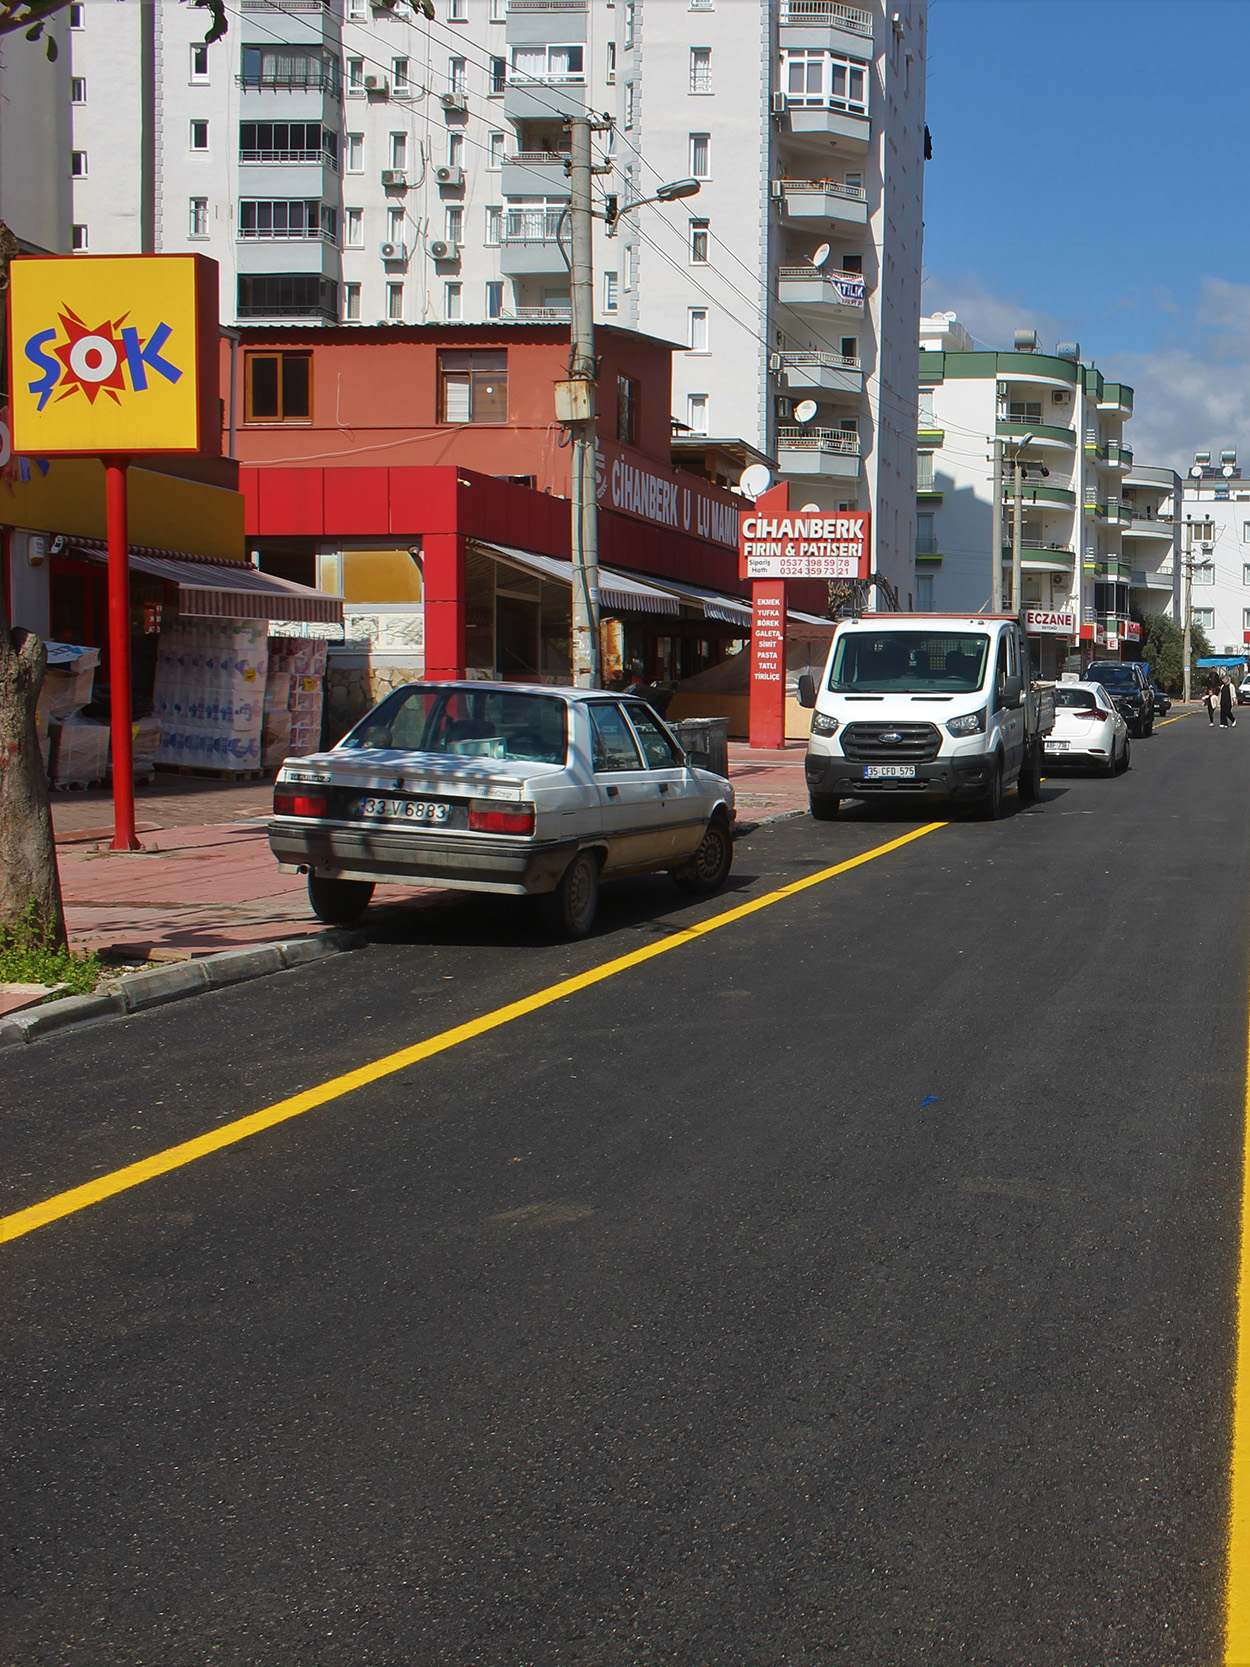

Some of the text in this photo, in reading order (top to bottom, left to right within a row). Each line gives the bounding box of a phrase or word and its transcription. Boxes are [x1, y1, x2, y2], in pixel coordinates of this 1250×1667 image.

[24, 322, 184, 412] ŞOK
[612, 453, 679, 528] CİHANBERK
[742, 512, 864, 539] CİHANBERK
[744, 539, 863, 557] FIRIN & PATİSERİ
[749, 559, 850, 567] Sipariş 0537 398 59 78
[757, 598, 780, 606] EKMEK
[757, 609, 780, 617] YUFKA
[756, 618, 780, 627] BÖREK
[1027, 612, 1072, 626] ECZANE
[757, 651, 778, 659] PASTA
[868, 767, 878, 775] 35
[900, 767, 914, 775] 575
[365, 799, 447, 819] 33 V 6883
